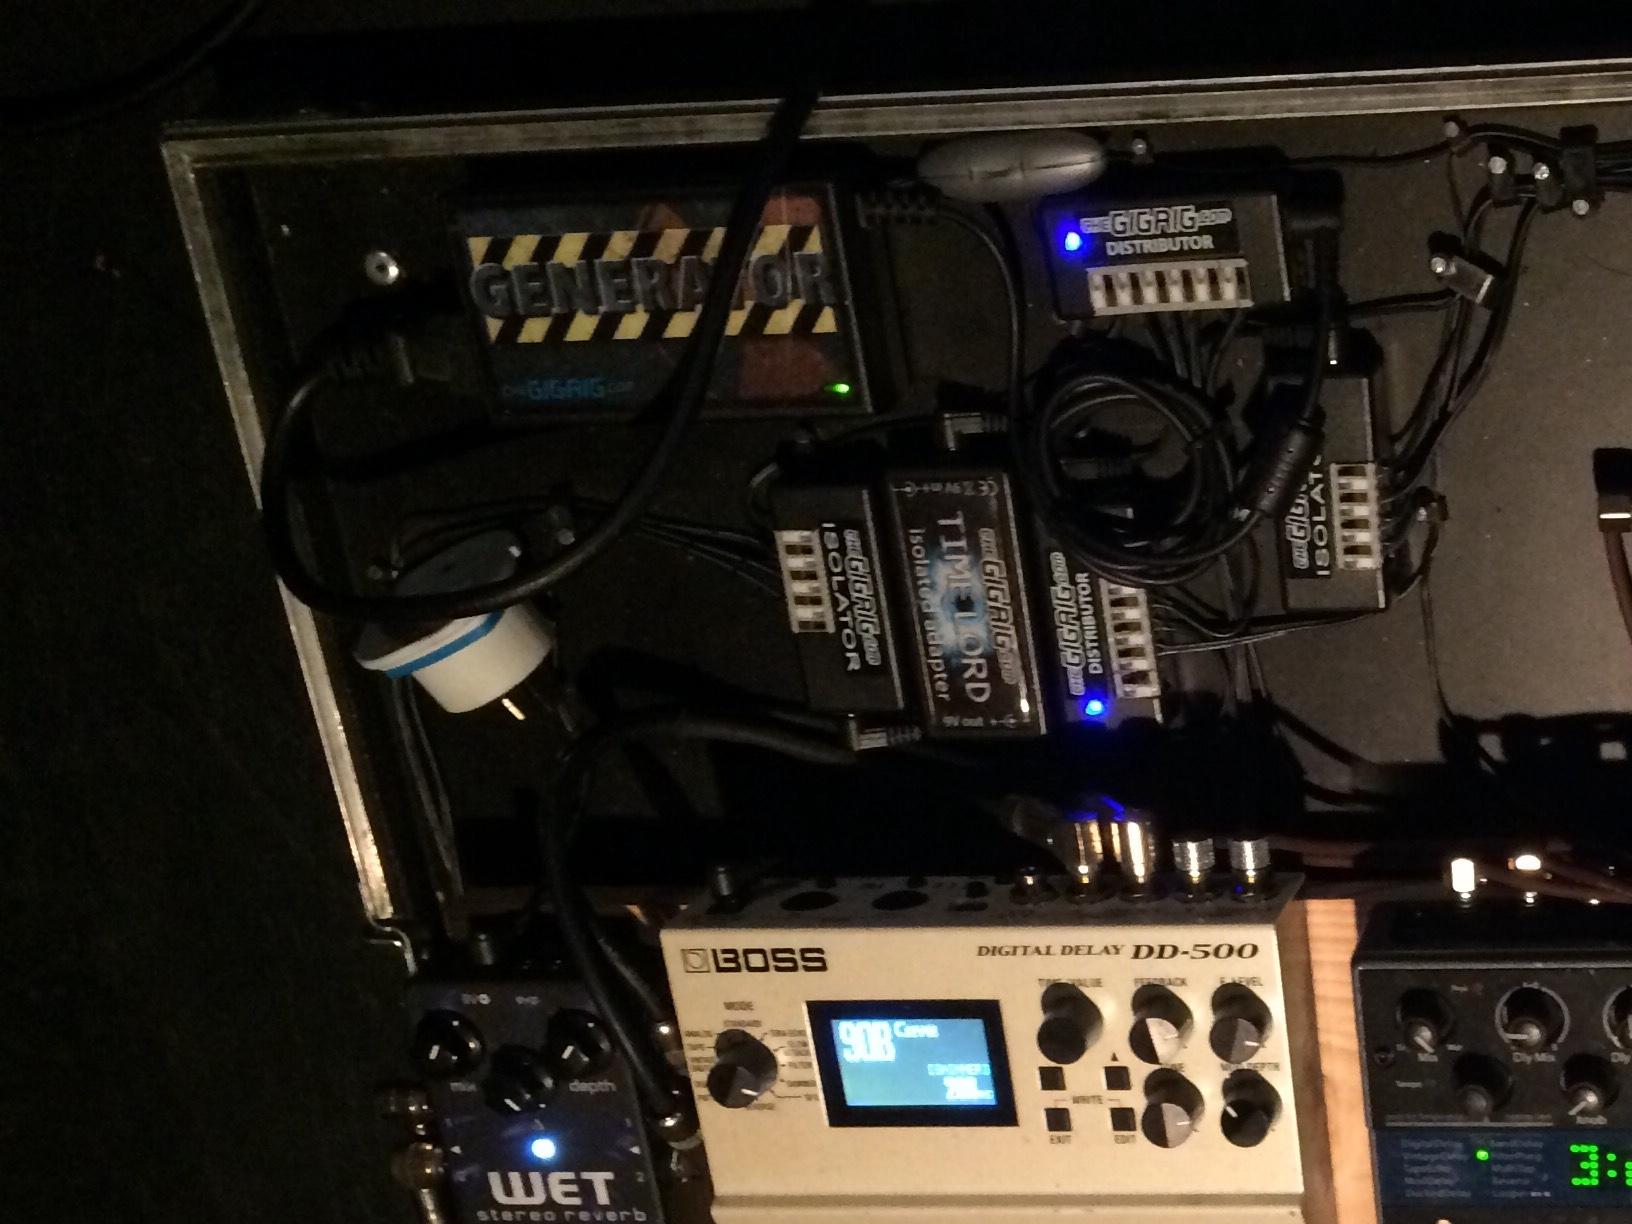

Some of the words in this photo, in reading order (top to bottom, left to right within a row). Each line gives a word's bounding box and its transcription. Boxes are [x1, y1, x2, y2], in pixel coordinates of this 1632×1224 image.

[1104, 234, 1216, 256] DISTRIBUTOR
[470, 250, 835, 318] GENERAOR
[1308, 455, 1332, 577] ISOLAT
[821, 522, 862, 672] ISOLATOR
[1074, 571, 1104, 676] DISTRIBUTOR
[711, 947, 829, 973] BOSS
[976, 944, 1055, 957] DIGITAL
[1061, 943, 1125, 956] DELAY
[1131, 942, 1259, 960] DD-500
[487, 1171, 616, 1205] WET
[476, 1209, 557, 1222] stereo
[563, 1207, 648, 1222] reverb
